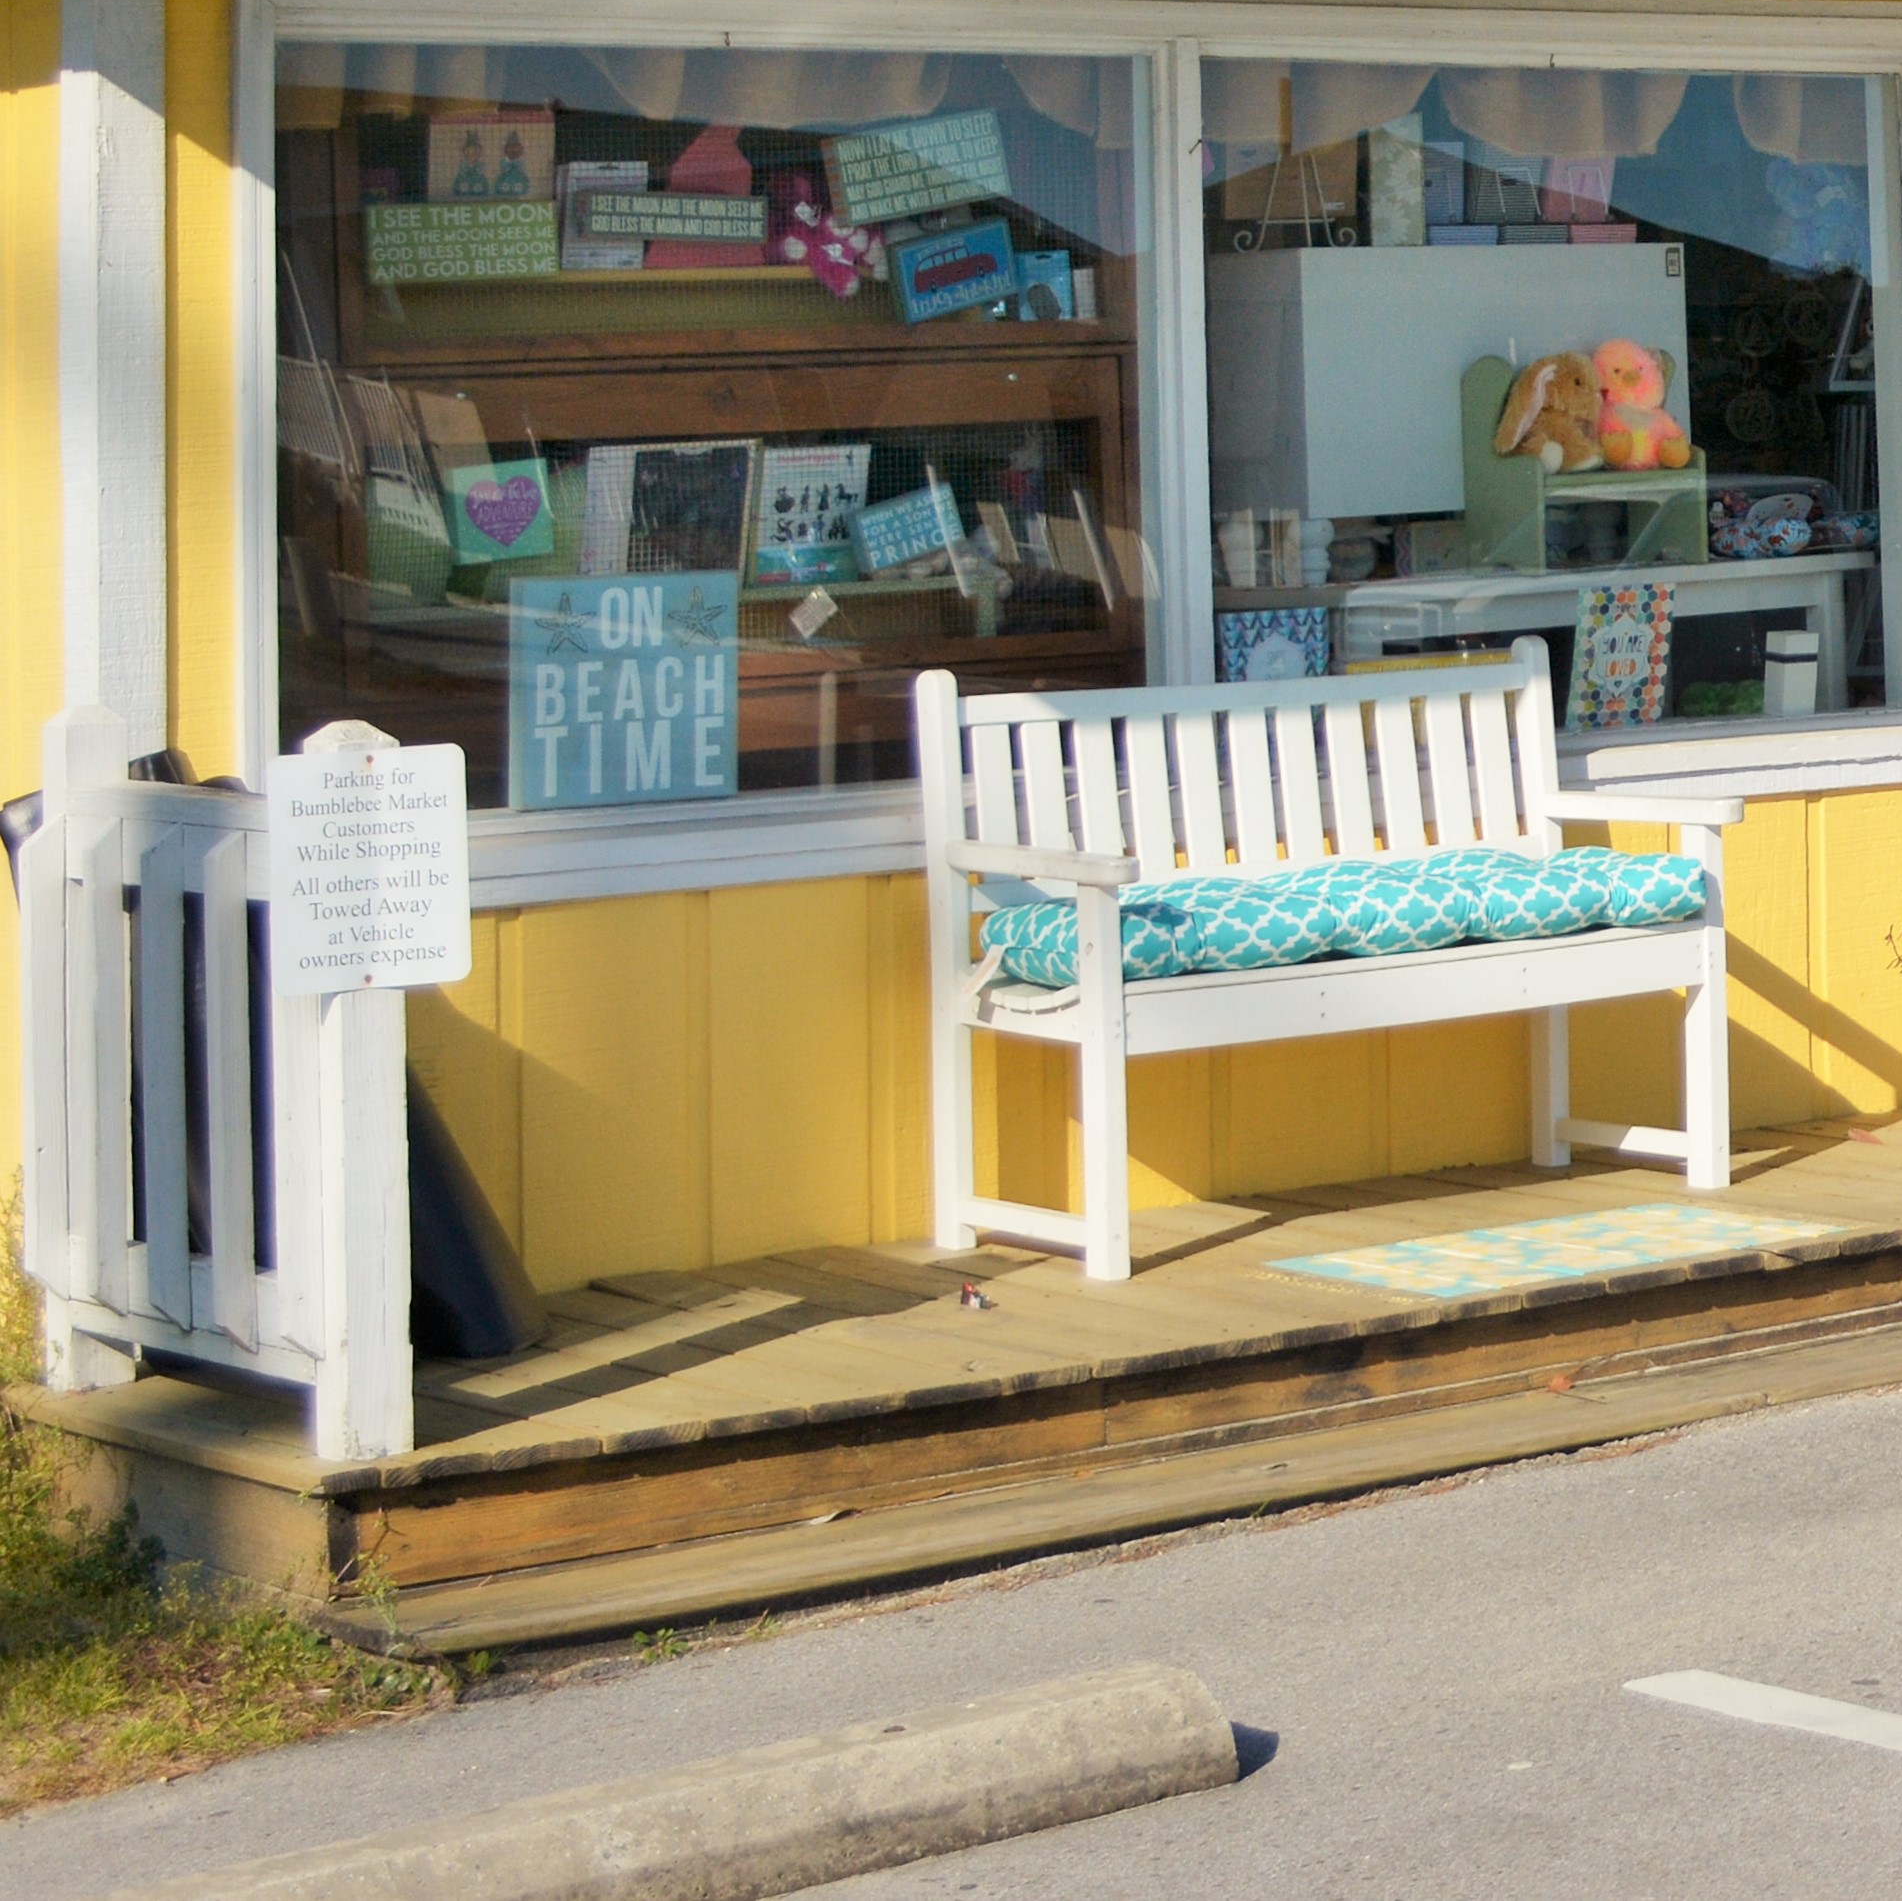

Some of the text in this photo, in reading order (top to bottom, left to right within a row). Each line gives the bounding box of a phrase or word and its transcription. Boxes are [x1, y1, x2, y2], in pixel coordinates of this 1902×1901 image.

[838, 138, 867, 163] NOW
[872, 133, 893, 156] LAY
[912, 122, 946, 148] DOWN
[948, 119, 962, 142] TO
[964, 112, 993, 137] SLEEP
[849, 160, 873, 182] PRAY
[975, 136, 998, 157] KEEP
[369, 203, 553, 230] I SEE THE MOON
[597, 195, 614, 212] SEE
[615, 196, 631, 213] THE
[632, 197, 660, 214] MOON
[661, 198, 681, 215] AND
[681, 199, 698, 216] THE
[699, 199, 726, 217] MOON
[727, 200, 749, 217] SEES
[750, 201, 763, 218] ME
[373, 225, 554, 246] AND THE MOON SEES ME
[592, 215, 763, 238] GOD BLESS THE MOON AND GOD BLESS ME
[373, 241, 556, 262] GOD BLESS THE MOON
[375, 257, 556, 280] AND GOD BLESS ME
[862, 510, 894, 525] WHEN
[863, 523, 888, 539] FOR
[867, 531, 903, 547] WERE
[870, 524, 961, 569] PRINCE
[600, 585, 664, 649] ON
[536, 654, 725, 726] BEACH
[534, 716, 725, 797] TIME
[323, 768, 415, 790] Parking for
[291, 792, 448, 817] Bumblebee Market
[322, 819, 415, 838] Customers
[297, 838, 441, 862] While Shopping
[292, 869, 450, 897] All others will be
[310, 897, 432, 920] Towed Away
[328, 924, 414, 945] at Vehicle
[299, 945, 447, 969] owners expense
